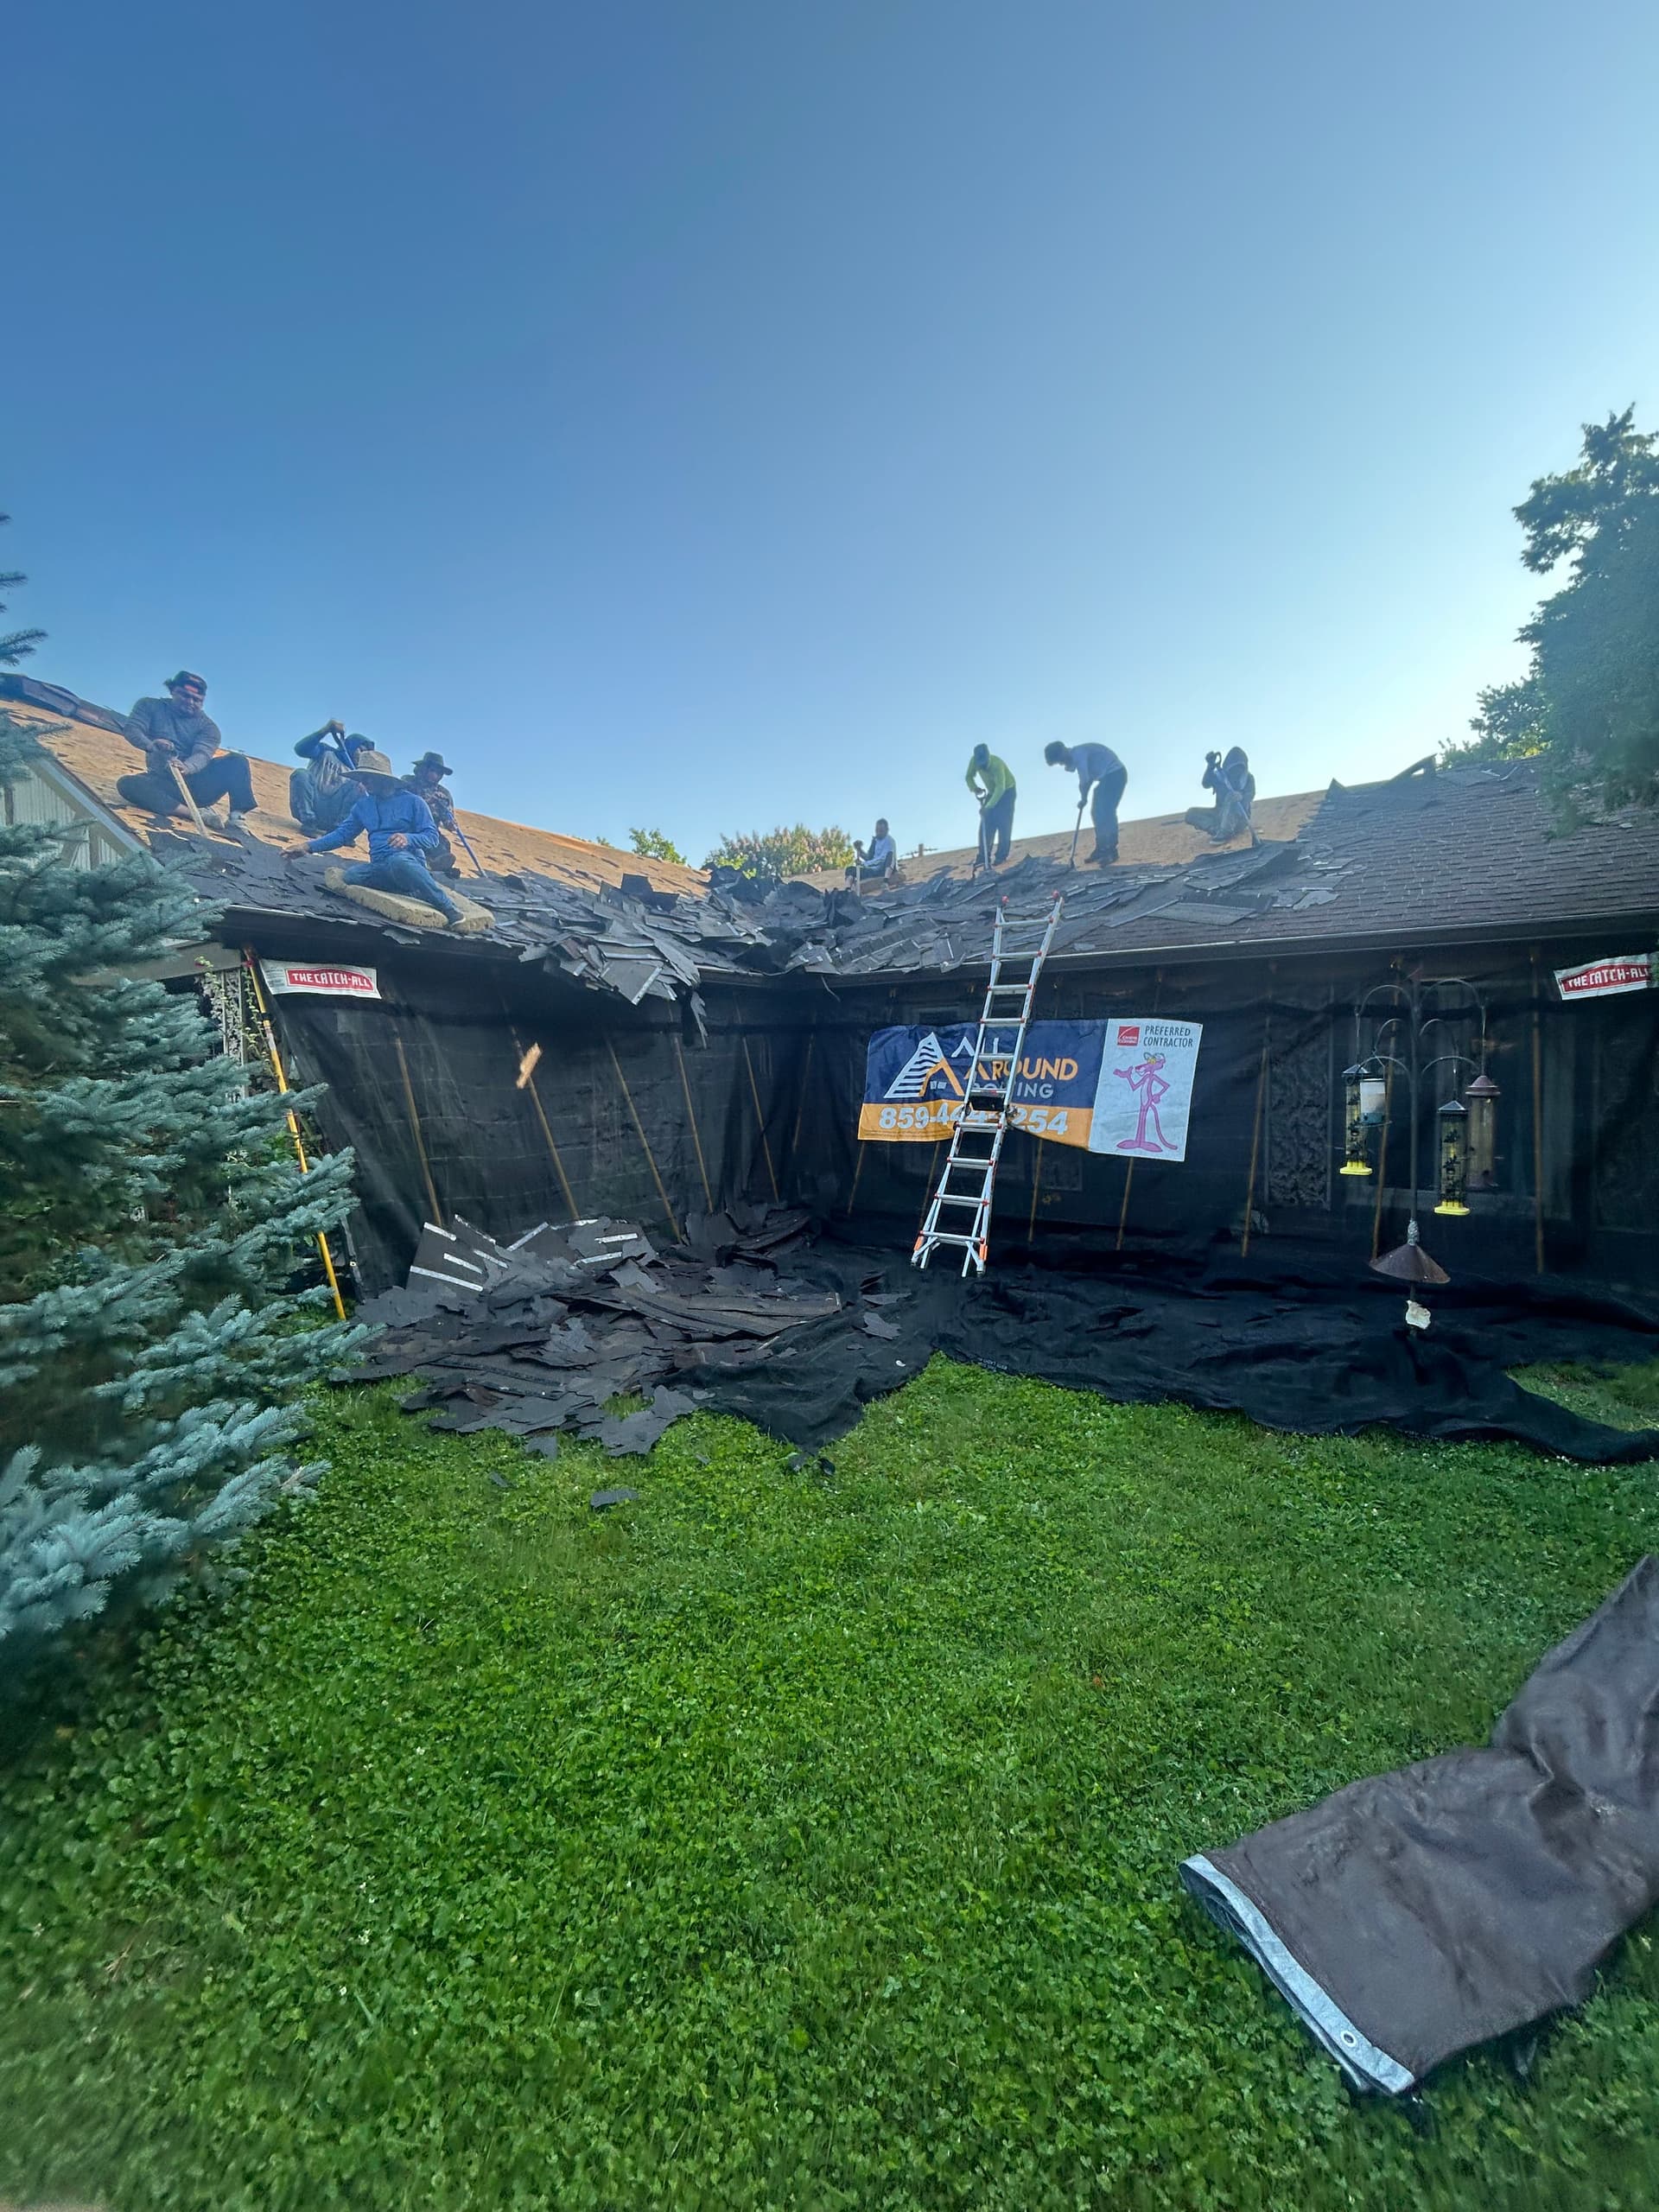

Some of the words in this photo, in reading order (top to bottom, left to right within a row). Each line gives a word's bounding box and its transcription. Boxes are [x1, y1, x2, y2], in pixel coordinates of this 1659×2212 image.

[292, 973, 313, 983] THE
[1568, 976, 1588, 988] THE
[1145, 1025, 1191, 1036] PREFERRED
[950, 1036, 1002, 1058] AL
[1143, 1037, 1193, 1047] CONTRACTOR
[879, 1103, 1068, 1135] 859-444-254
